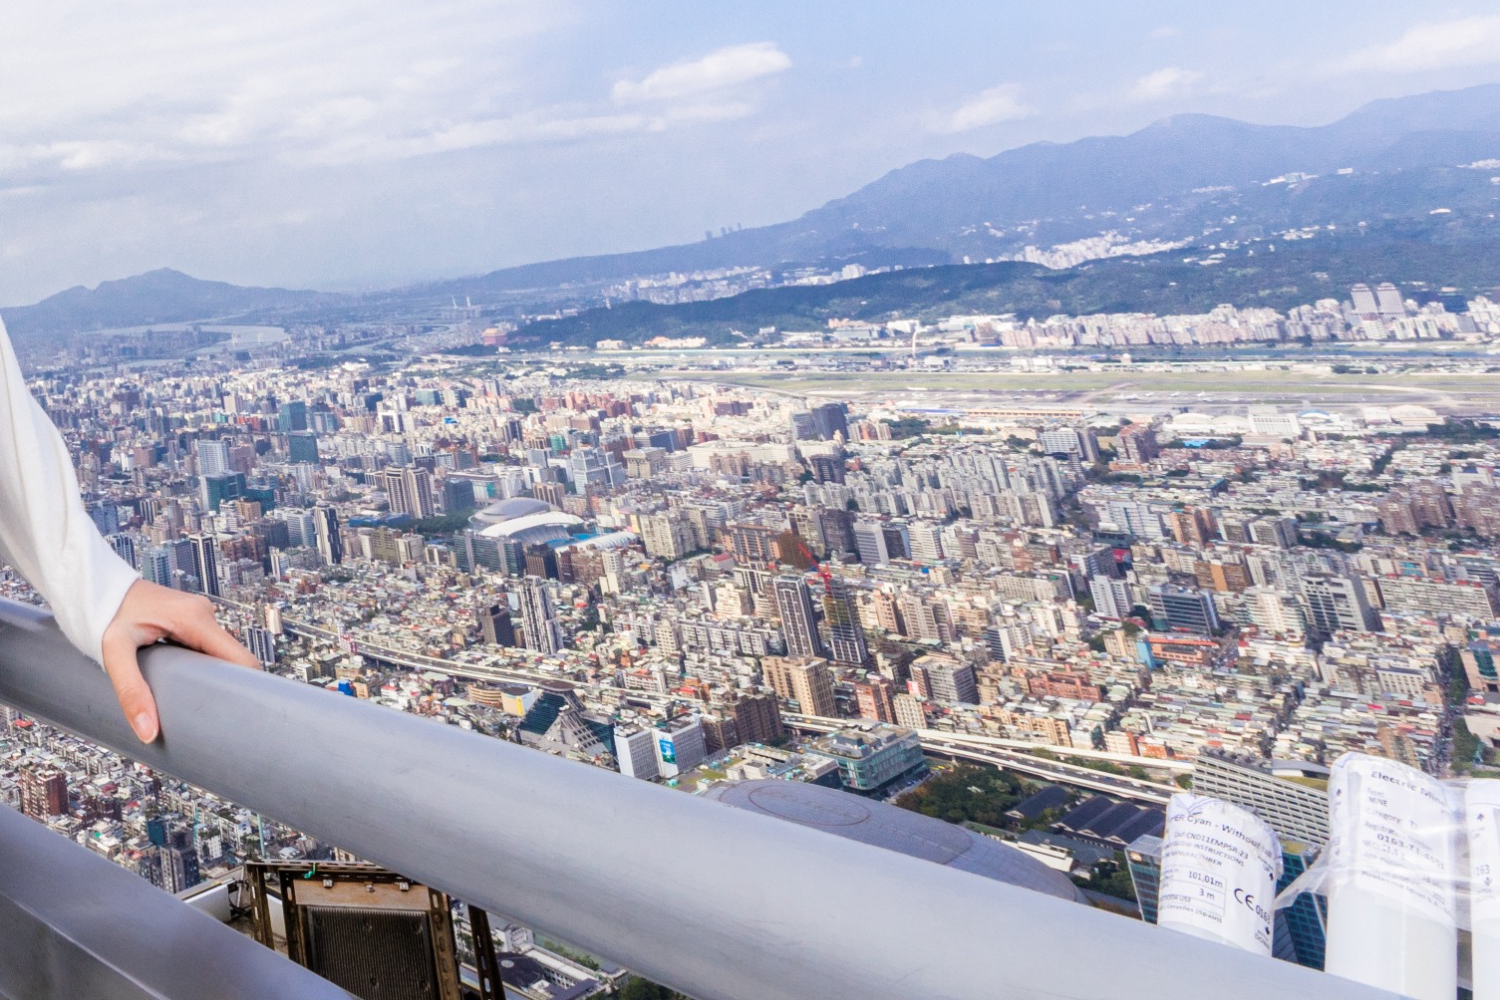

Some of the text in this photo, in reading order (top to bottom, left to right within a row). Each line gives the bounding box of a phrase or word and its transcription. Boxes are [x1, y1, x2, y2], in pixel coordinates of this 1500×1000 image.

[1371, 770, 1418, 792] Electric
[1187, 814, 1212, 827] Cyan
[1222, 823, 1261, 849] Without
[1193, 843, 1245, 868] INSTRUCTIONS
[1199, 888, 1215, 901] 3 m
[1233, 887, 1255, 911] CE
